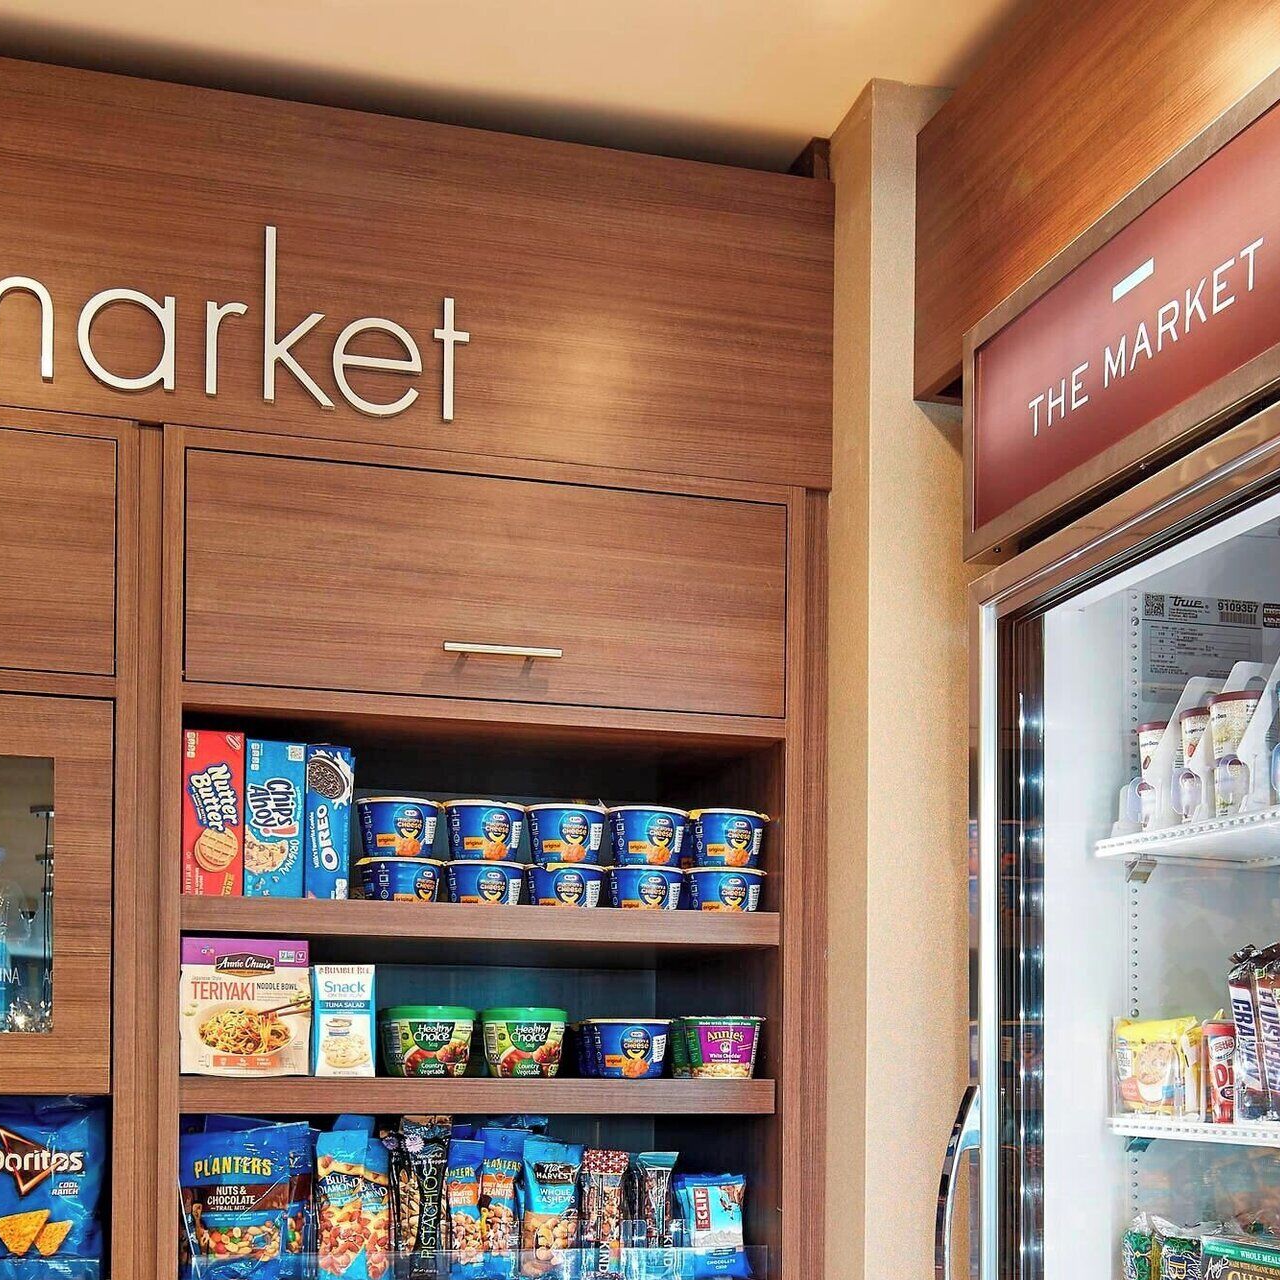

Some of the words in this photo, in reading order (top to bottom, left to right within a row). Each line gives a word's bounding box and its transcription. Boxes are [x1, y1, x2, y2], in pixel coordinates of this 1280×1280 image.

[1028, 361, 1089, 437] THE
[1104, 237, 1264, 388] MARKET
[1217, 602, 1259, 614] 9109357
[207, 763, 238, 827] Nutter
[190, 772, 224, 832] Butter
[320, 804, 339, 872] OREO
[220, 956, 244, 969] Annie
[191, 982, 255, 1000] TERIYAKI
[280, 982, 298, 990] BOWL
[324, 981, 366, 993] Snack
[418, 1023, 452, 1036] Healthy
[413, 1031, 449, 1042] Choice
[706, 1030, 745, 1042] Annie's
[420, 1062, 443, 1070] Country
[194, 1157, 272, 1178] PLANTERS
[326, 1174, 348, 1185] BLUE
[216, 1186, 238, 1196] NUTS
[239, 1186, 246, 1194] &
[207, 1195, 256, 1205] CHOCOLATE
[421, 1166, 437, 1259] PISTACHIOS
[1240, 1251, 1263, 1262] WHOLE
